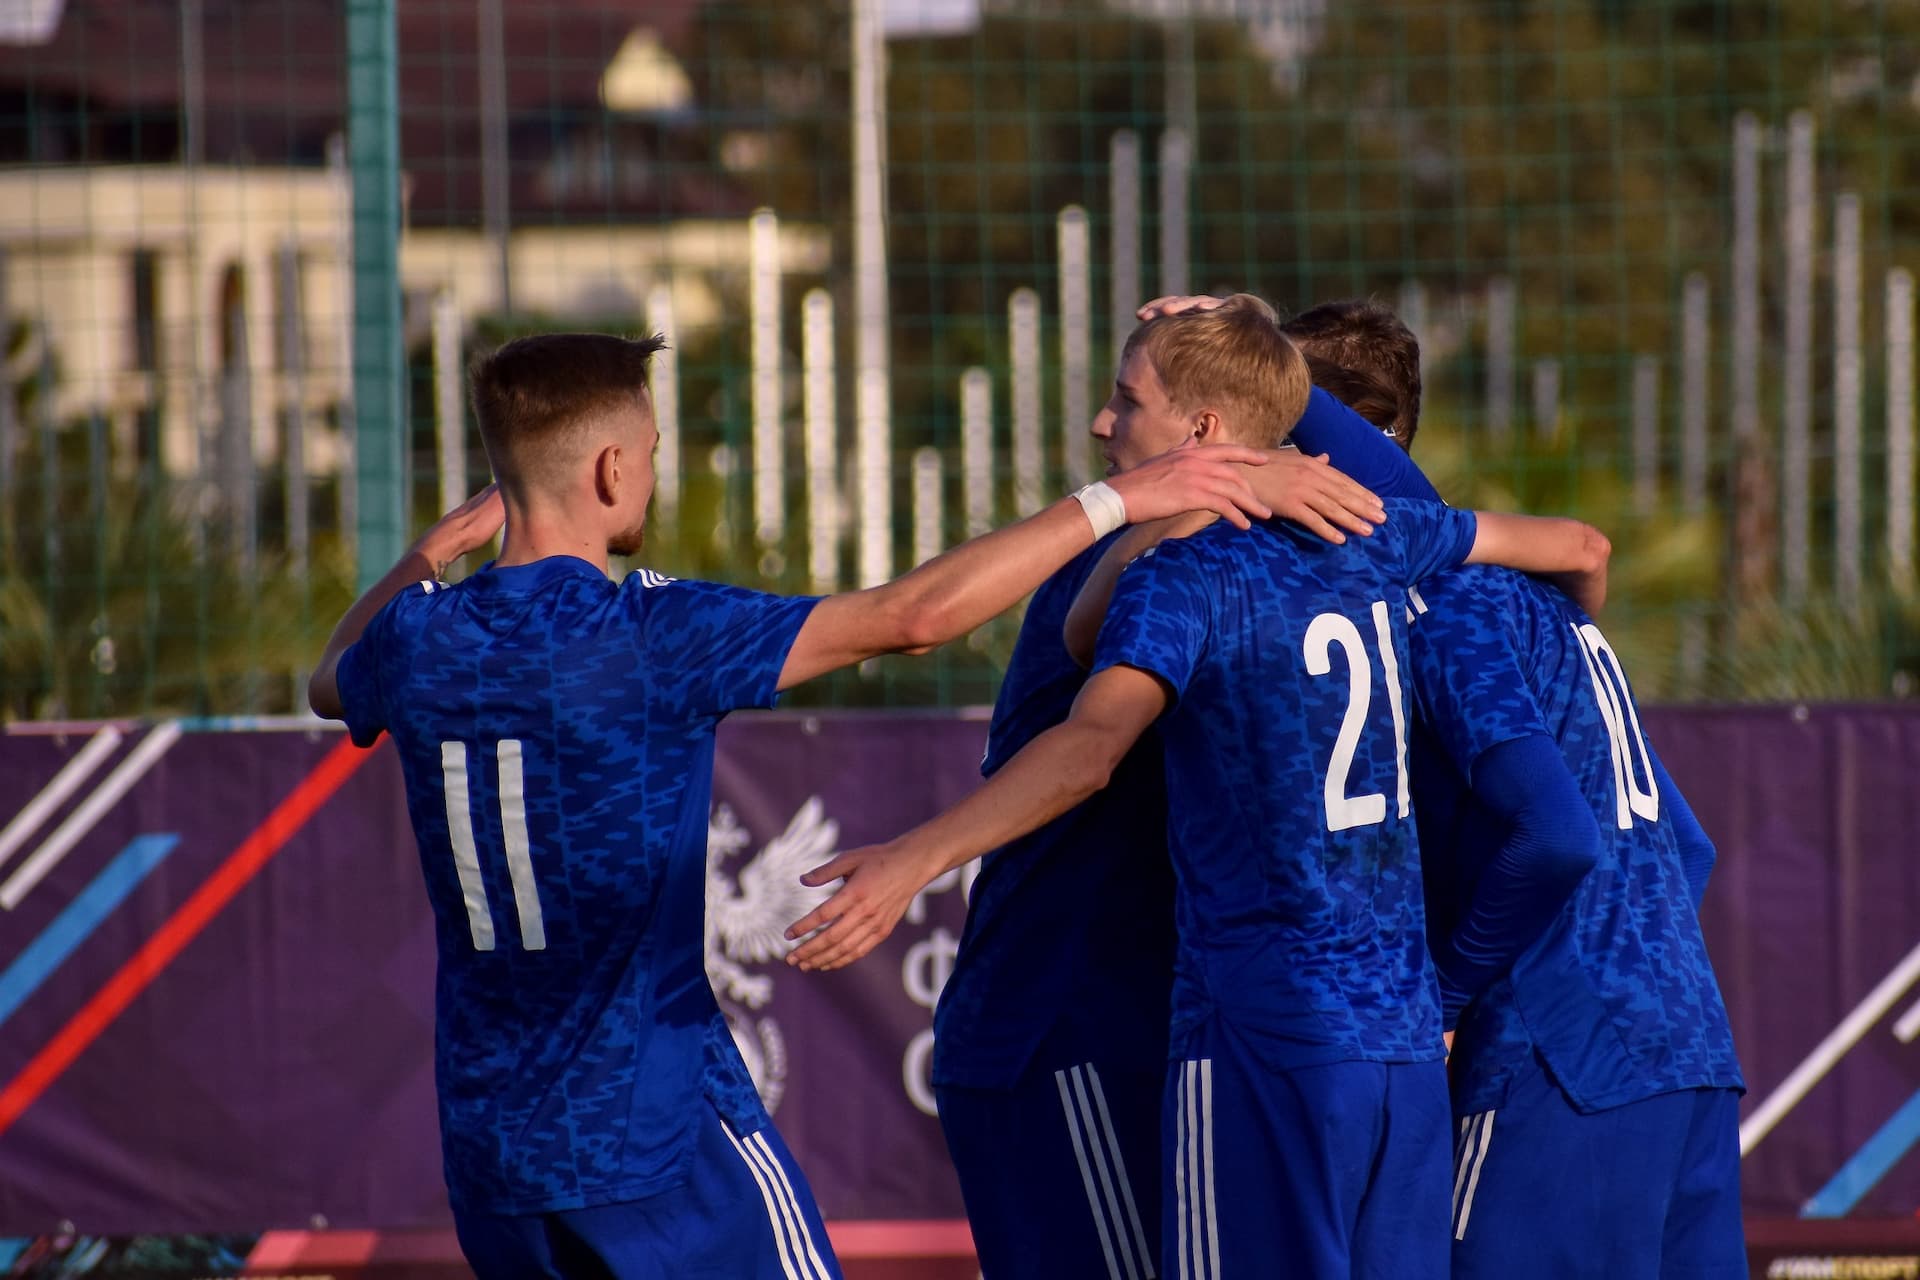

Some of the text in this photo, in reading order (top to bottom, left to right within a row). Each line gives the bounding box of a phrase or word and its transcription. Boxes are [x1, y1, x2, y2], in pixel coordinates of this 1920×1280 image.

[1303, 600, 1411, 832] 21
[1570, 622, 1659, 830] 10
[441, 739, 546, 951] 11
